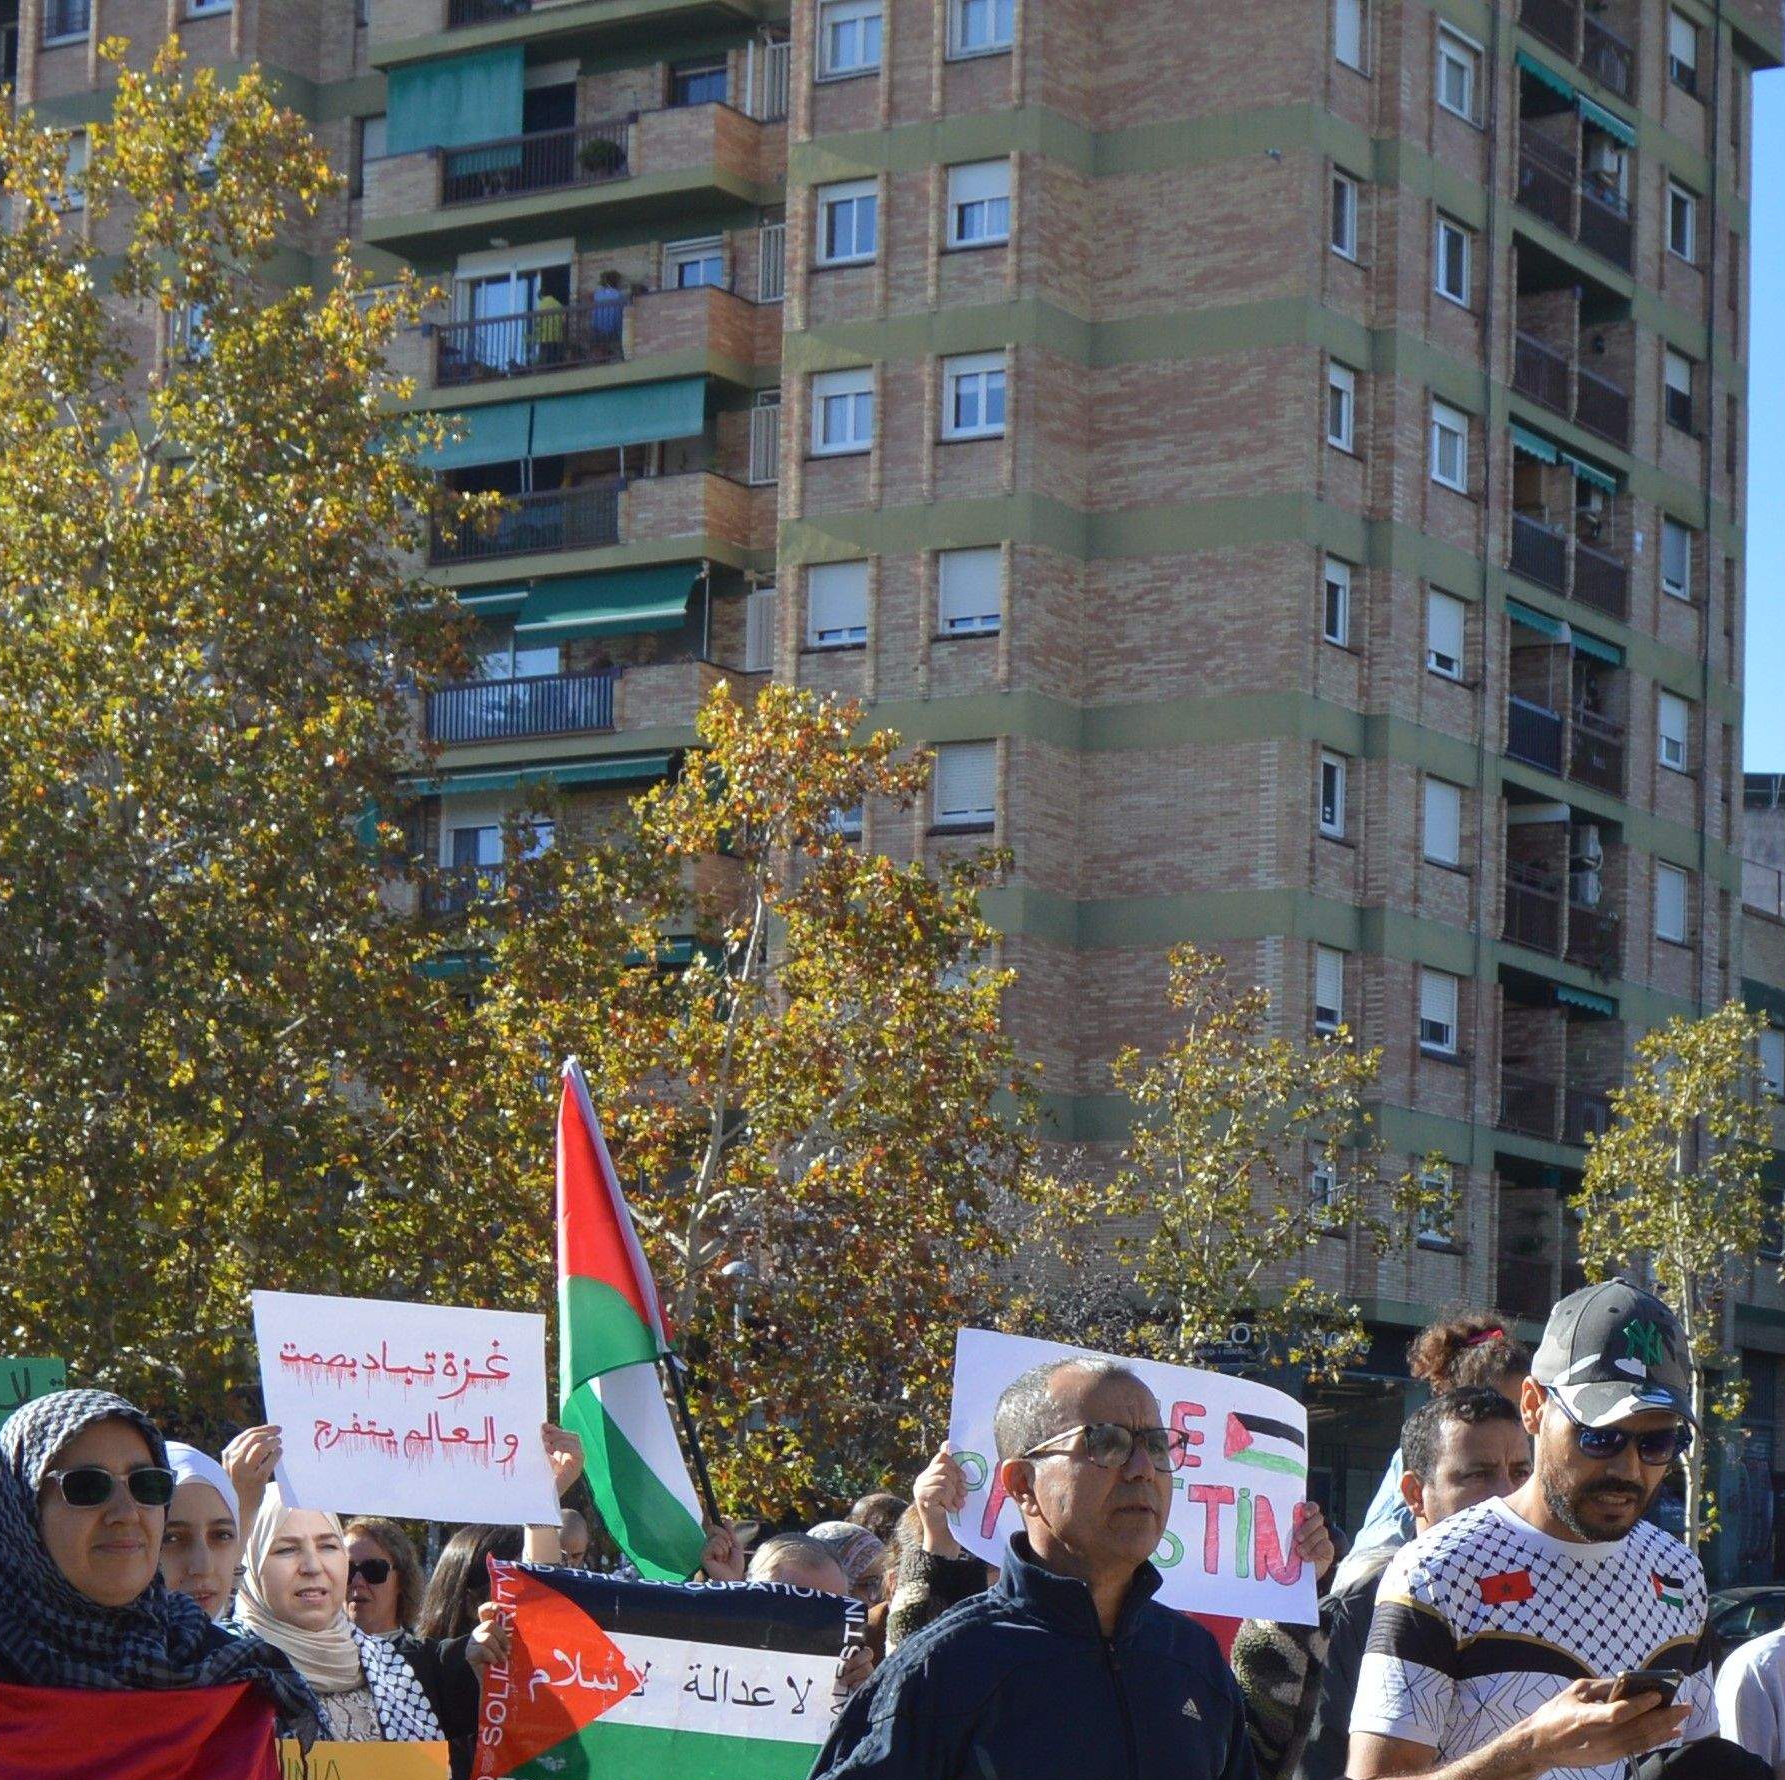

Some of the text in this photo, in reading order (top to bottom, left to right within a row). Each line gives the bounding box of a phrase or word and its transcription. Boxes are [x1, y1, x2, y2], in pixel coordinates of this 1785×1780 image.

[279, 1340, 511, 1400] غزة تباد بصمت
[314, 1411, 519, 1464] والعالم يتفرج
[682, 1662, 776, 1707] عدالة
[787, 1675, 814, 1715] لا
